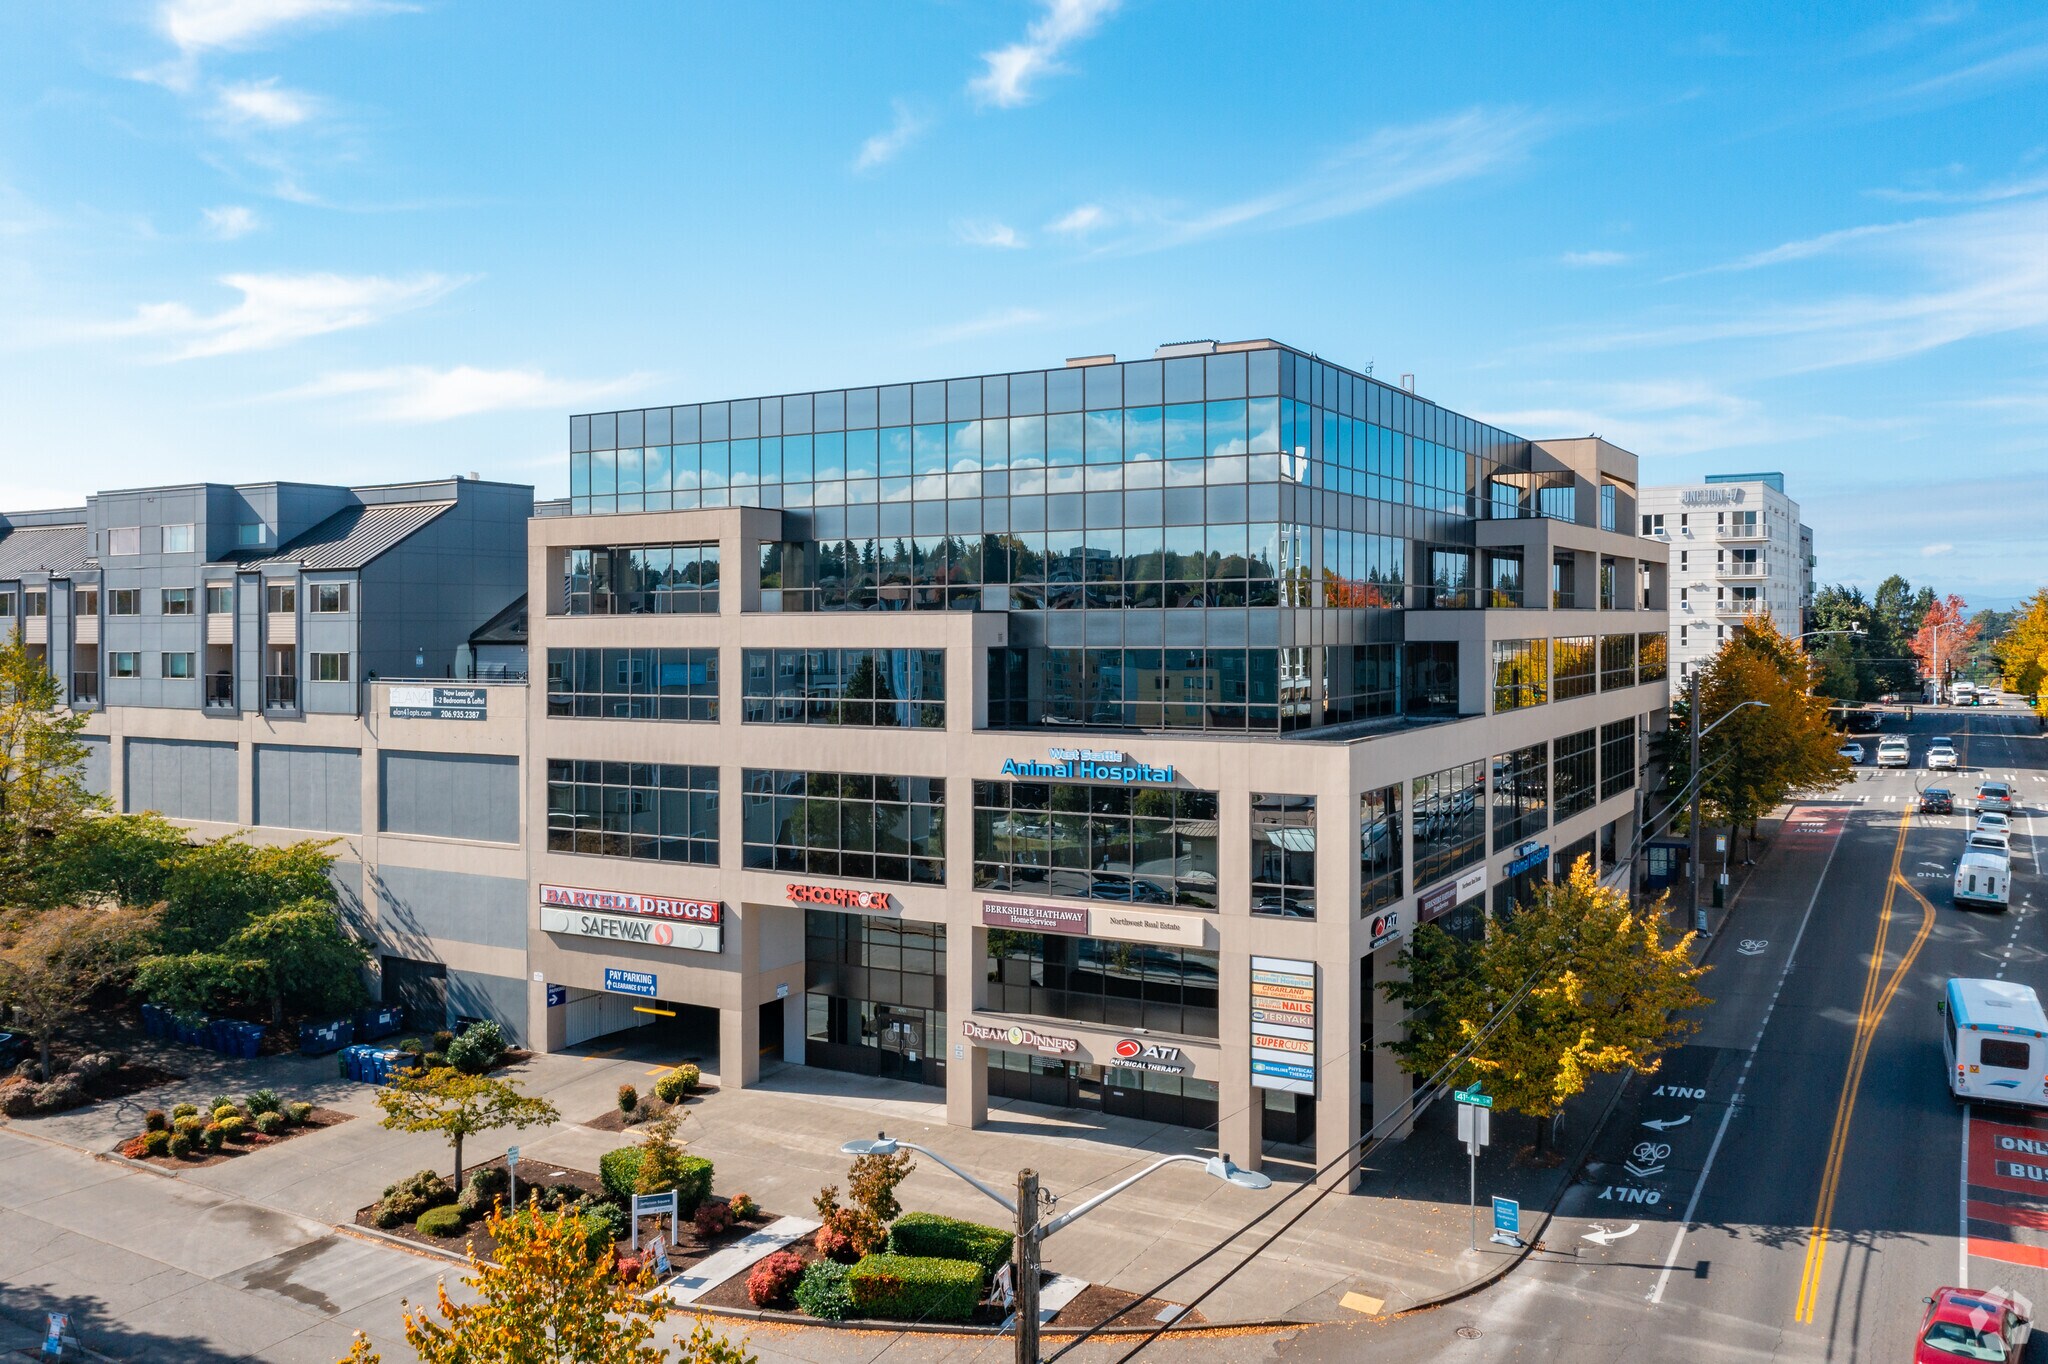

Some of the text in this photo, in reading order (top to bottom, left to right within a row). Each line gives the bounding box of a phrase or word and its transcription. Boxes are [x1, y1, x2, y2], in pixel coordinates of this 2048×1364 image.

[443, 689, 454, 697] Now
[443, 697, 466, 705] Bedrooms
[393, 708, 480, 719] elan41apts.com 206.935.2387
[1048, 748, 1124, 764] West Seattle
[1001, 758, 1174, 784] Animal Hospital
[545, 888, 714, 919] BARTELL DRUGS
[786, 884, 839, 905] SCHOOL
[847, 890, 890, 911] ROCK
[985, 904, 1084, 922] BERKSHIRE HATHAWAY
[581, 915, 652, 942] SAFEWAY
[1011, 915, 1058, 927] HomeServices
[1110, 917, 1181, 932] Northwest Real Estate
[609, 970, 652, 985] PAY PARKING
[1254, 974, 1279, 983] Animal
[1280, 976, 1312, 987] Hospital
[612, 982, 637, 991] CLEARANCE
[1262, 985, 1305, 995] CIGARLAND
[1282, 1001, 1312, 1013] NAILS
[1264, 1012, 1311, 1025] TERIYAKI
[963, 1021, 1078, 1053] DREAM DINNERS
[1255, 1036, 1309, 1052] SUPERCUTS
[1143, 1045, 1179, 1061] ATI
[1110, 1059, 1183, 1075] PHYSICAL THERAPY
[1652, 1085, 1706, 1099] ONLY
[2010, 1163, 2048, 1180] BU
[1598, 1186, 1661, 1205] ONLY
